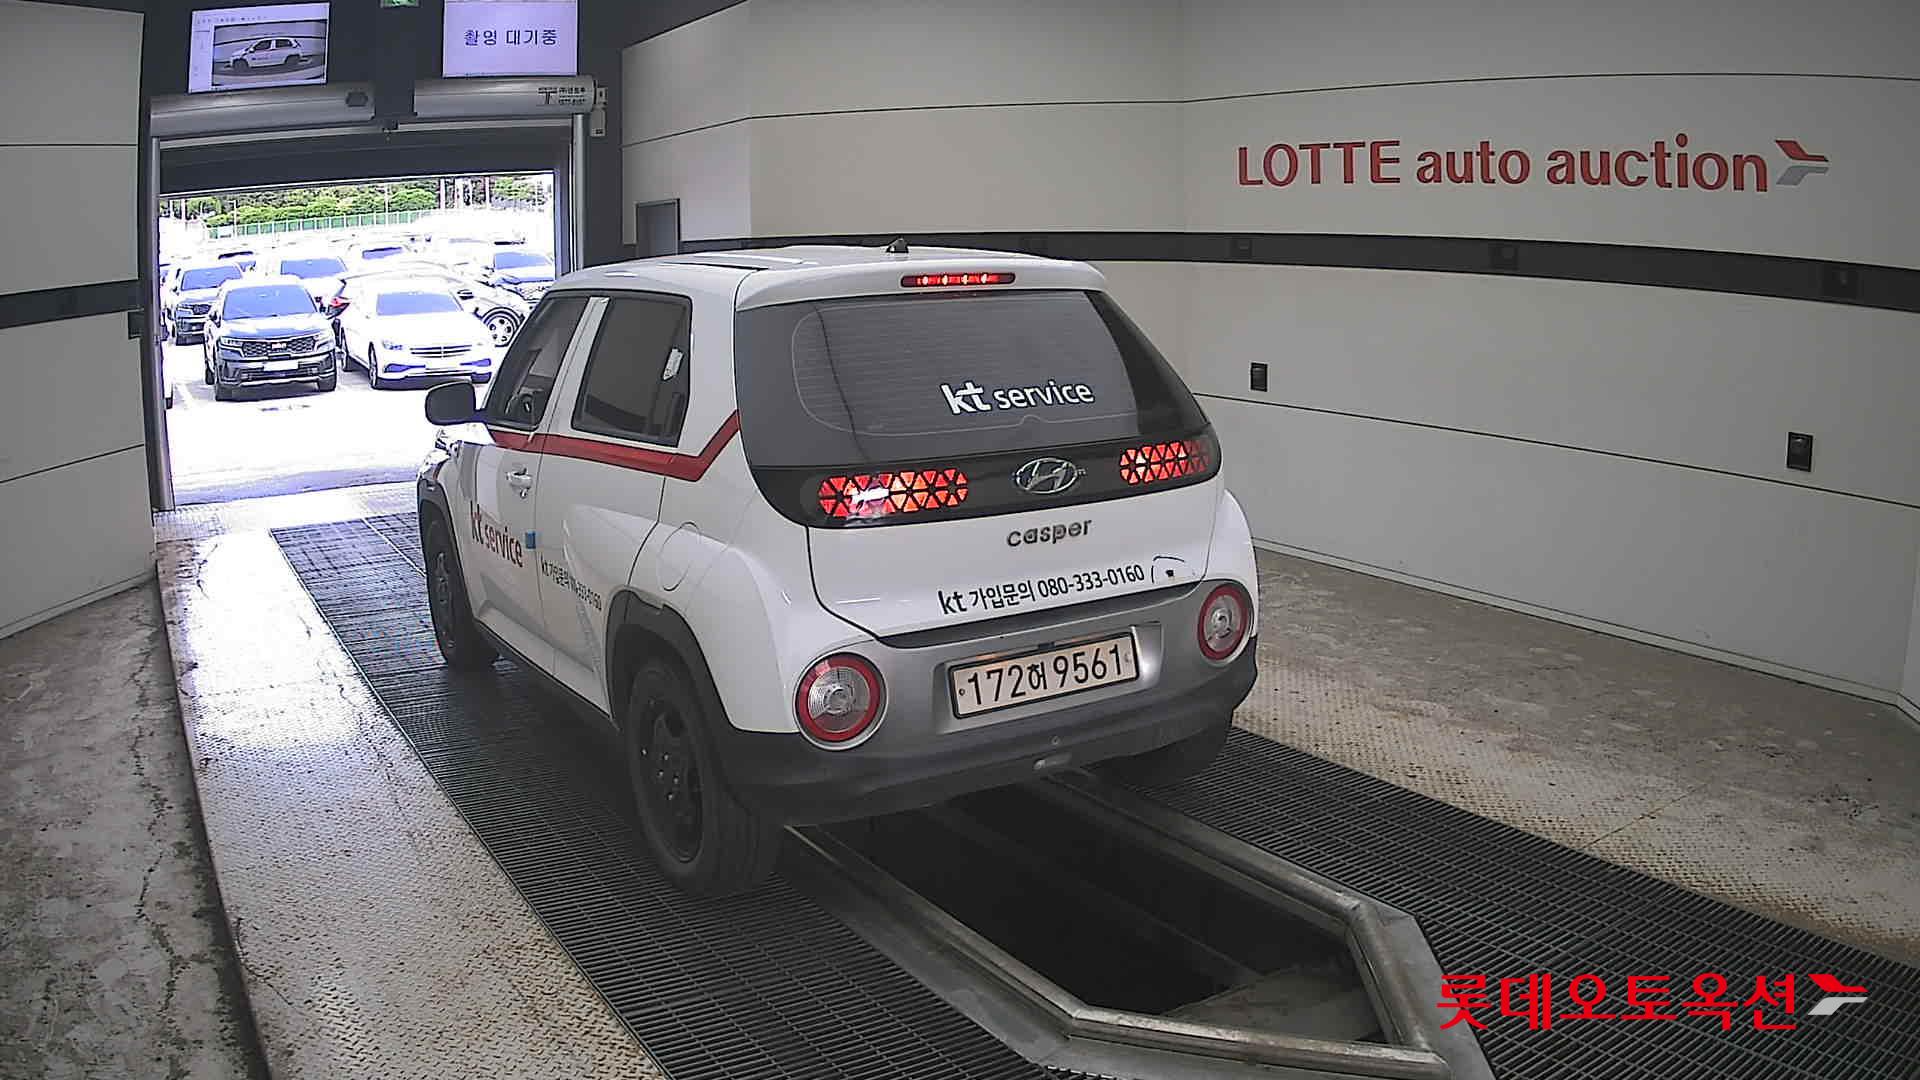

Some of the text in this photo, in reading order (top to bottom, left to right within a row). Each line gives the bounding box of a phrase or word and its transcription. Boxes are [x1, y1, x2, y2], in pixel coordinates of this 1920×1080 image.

[506, 29, 557, 46] 대기중
[1238, 133, 1768, 193] LOTTE auto auction
[940, 381, 1095, 415] kt service
[470, 500, 523, 568] kt service
[1007, 519, 1092, 548] casper
[938, 564, 1145, 615] kt 가입문의 080-333-0160
[1053, 644, 1124, 690] 9561
